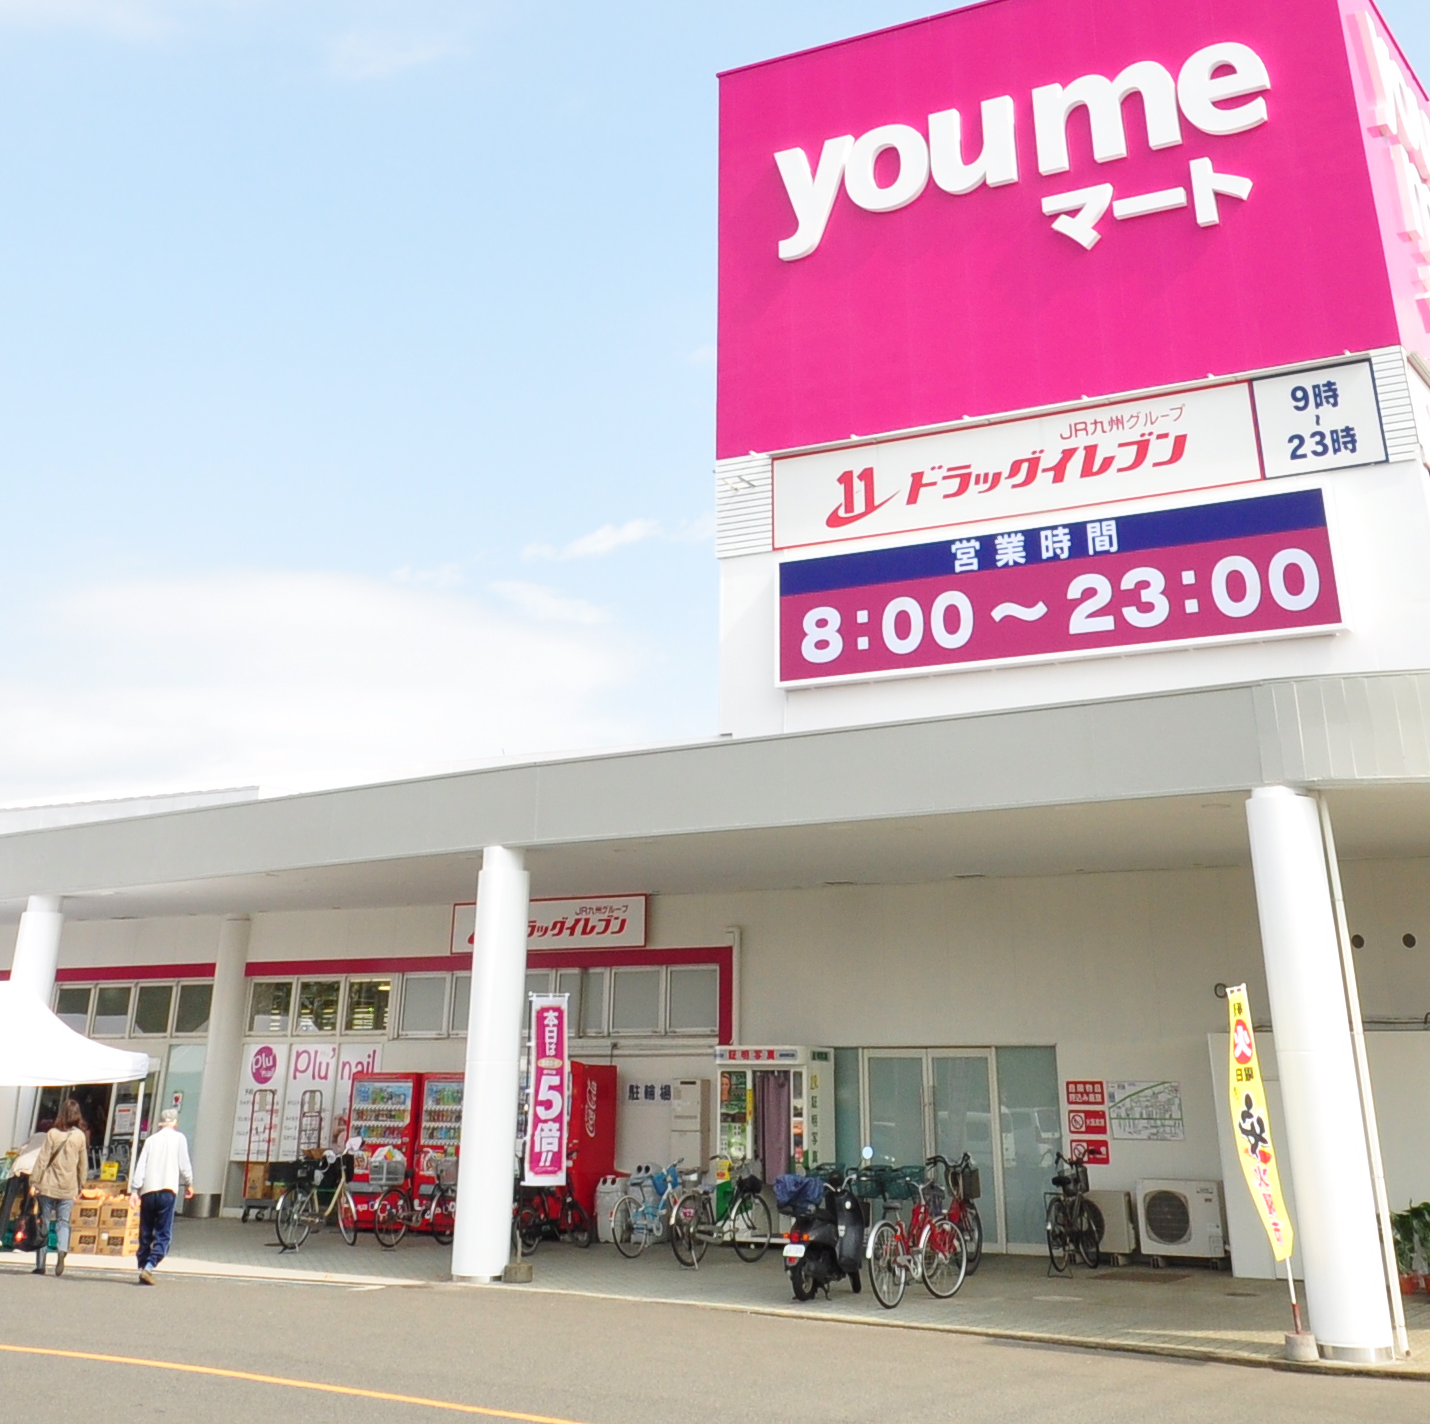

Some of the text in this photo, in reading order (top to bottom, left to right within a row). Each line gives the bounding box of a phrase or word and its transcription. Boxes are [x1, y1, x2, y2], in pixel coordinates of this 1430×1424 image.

[1041, 157, 1253, 250] マート
[1290, 381, 1340, 412] 9時
[1060, 403, 1187, 441] JR九州グループ
[1287, 426, 1358, 460] 23時
[905, 433, 1188, 506] ドラッグイレブン
[951, 519, 1119, 574] 営業時間
[575, 904, 629, 916] JR九州グループ
[543, 1009, 559, 1056] 本日は
